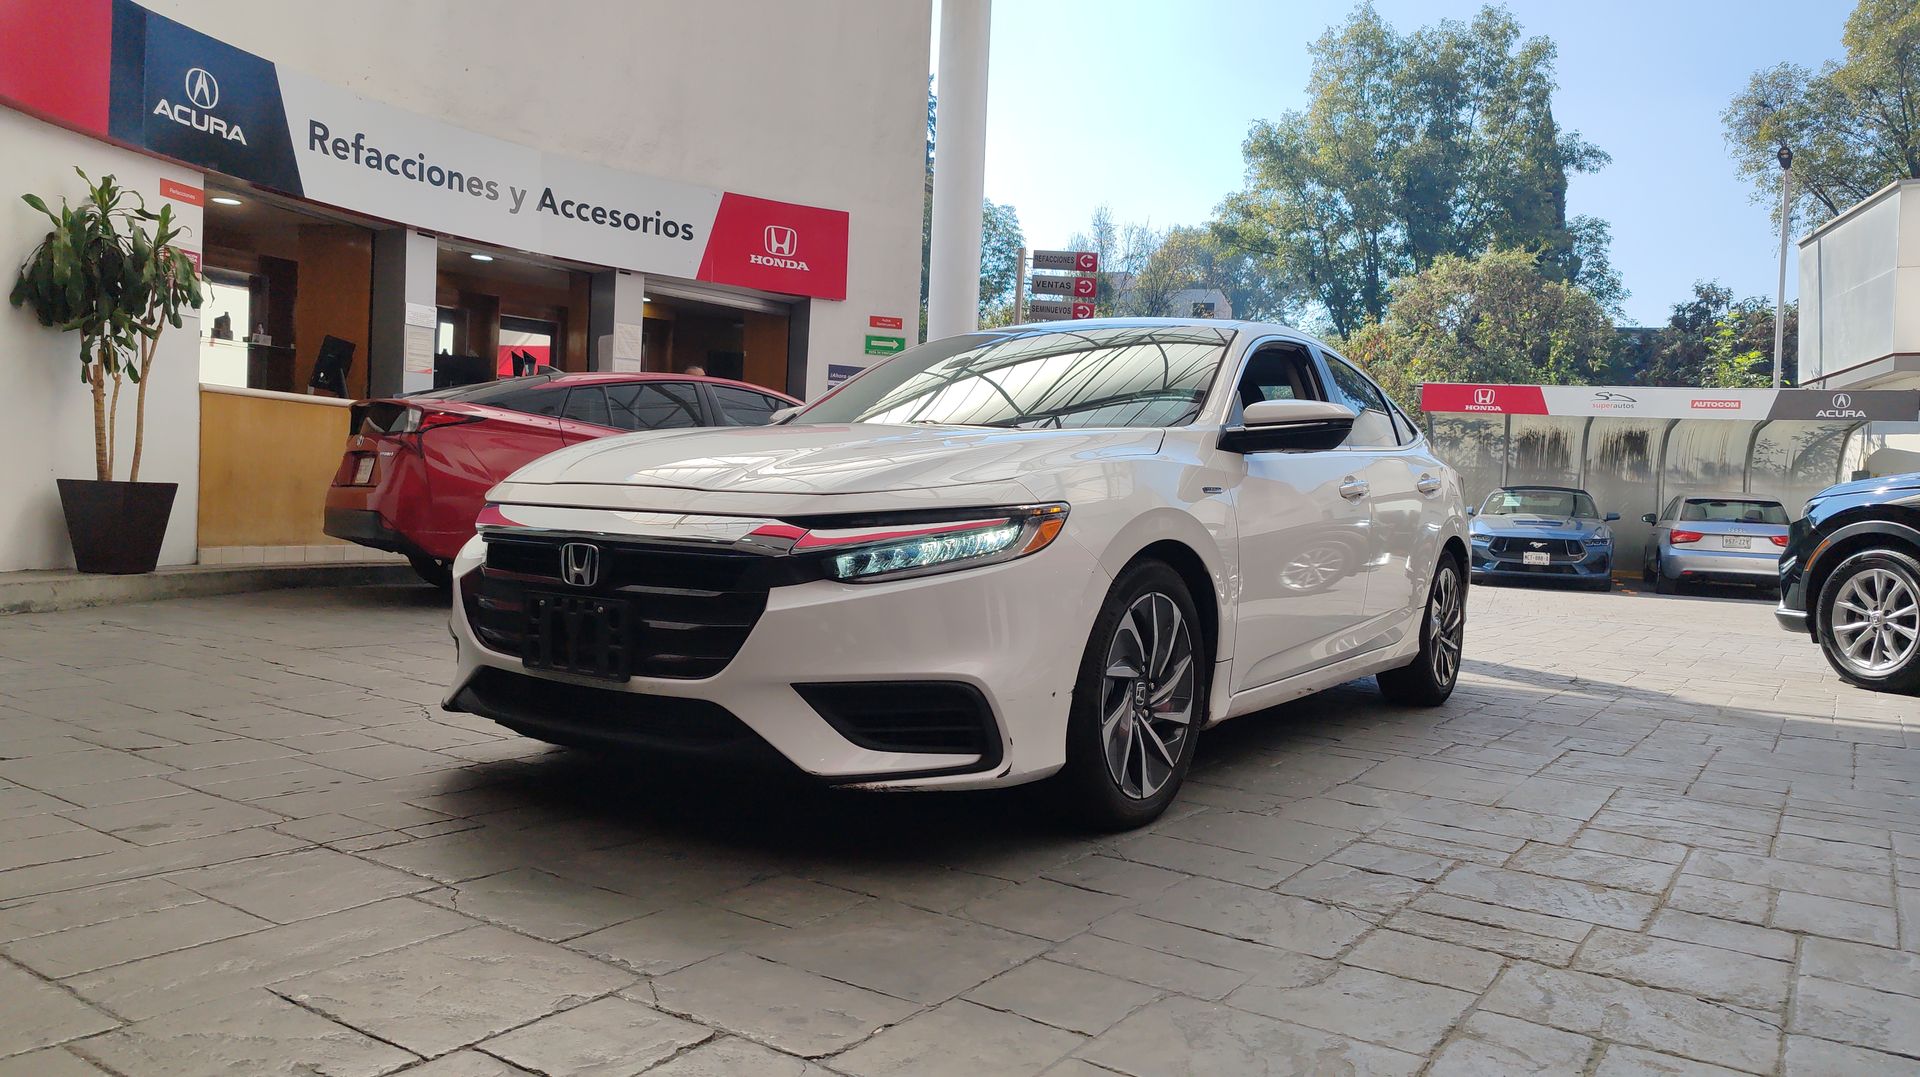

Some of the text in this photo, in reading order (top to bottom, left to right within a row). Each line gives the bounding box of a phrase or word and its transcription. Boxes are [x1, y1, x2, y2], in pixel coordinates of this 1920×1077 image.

[153, 98, 247, 146] ACURA
[308, 119, 694, 242] Refacciones y Accesorios
[749, 254, 810, 271] HONDA
[1034, 254, 1075, 264] REFACCIONES
[1036, 280, 1072, 290] VENTAS
[1031, 304, 1071, 315] SEMINUEVOS
[1465, 404, 1502, 412] HONDA
[1816, 409, 1867, 418] ACURA
